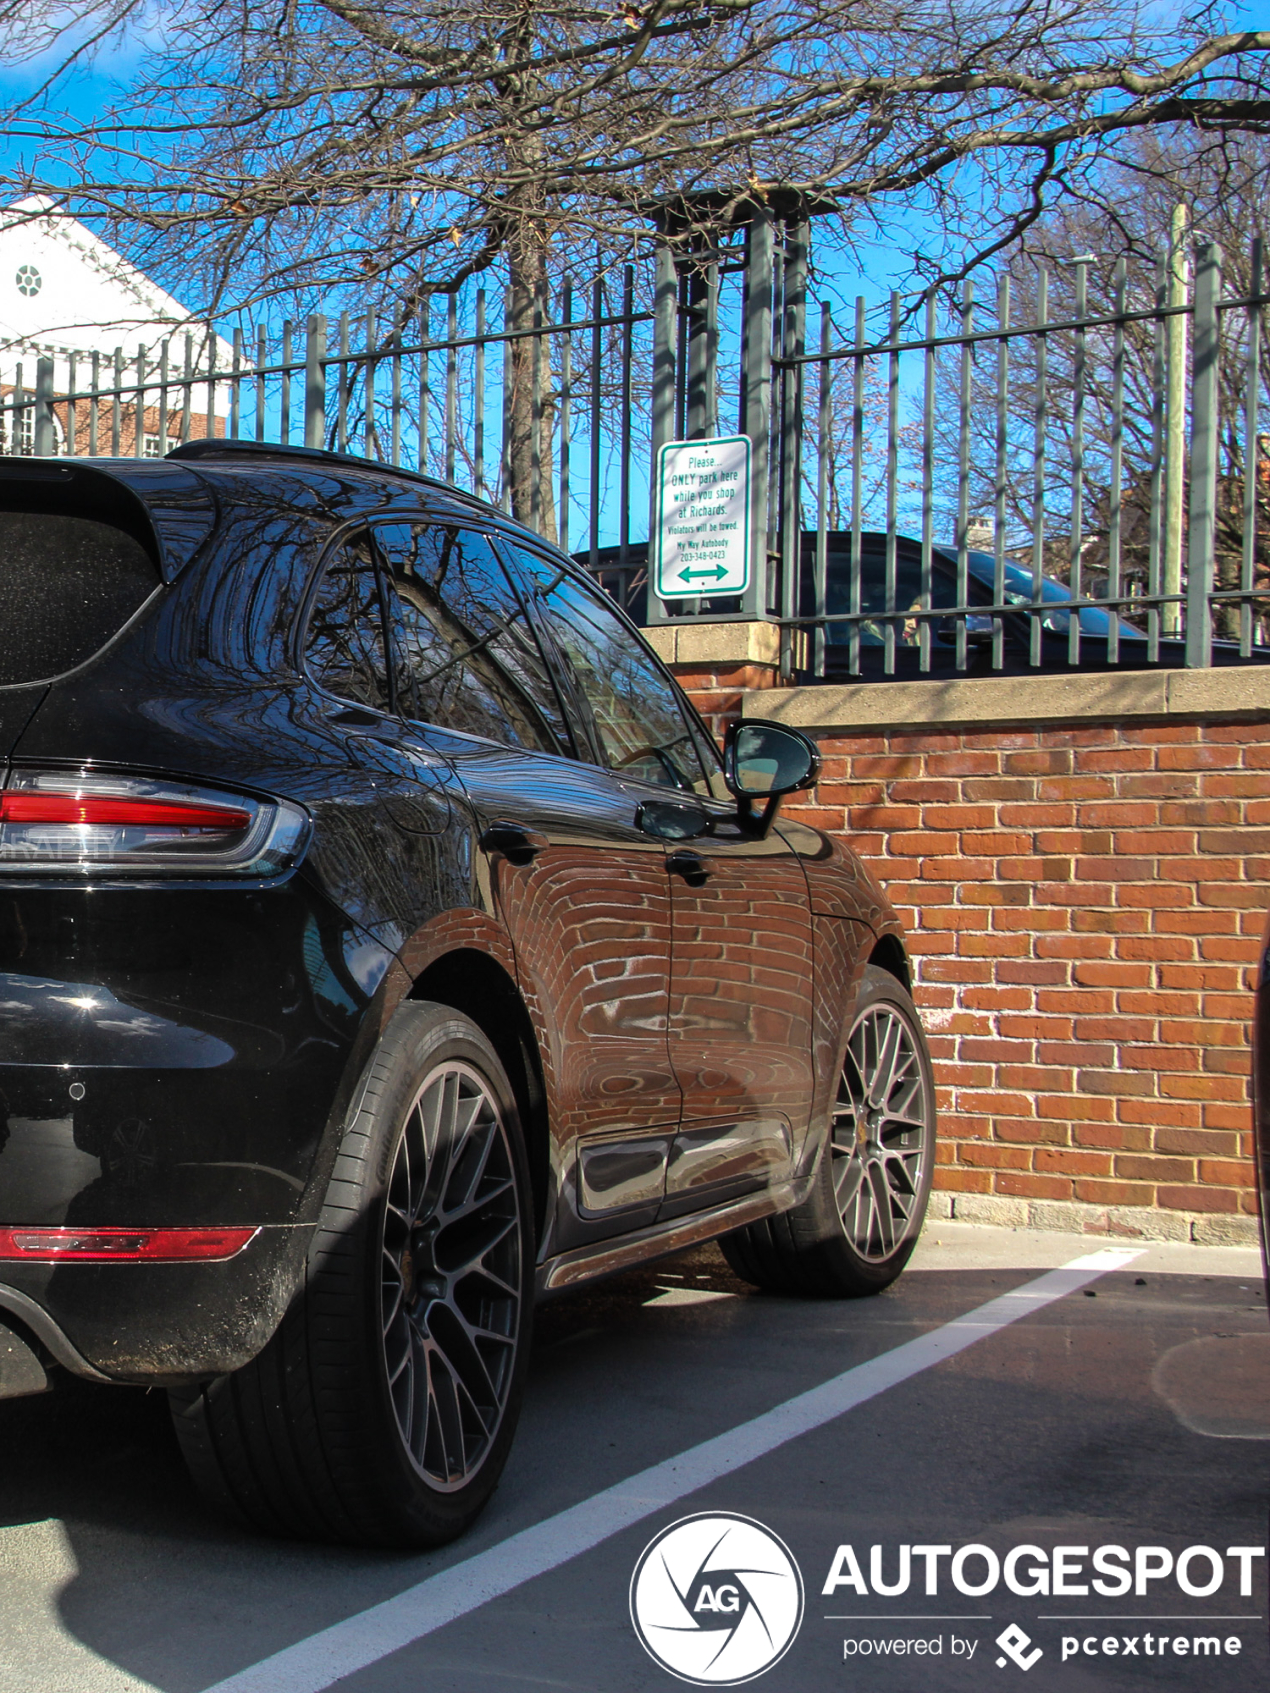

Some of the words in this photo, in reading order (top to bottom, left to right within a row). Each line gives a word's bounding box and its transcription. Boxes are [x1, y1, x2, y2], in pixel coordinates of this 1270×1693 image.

[688, 457, 722, 469] Please...
[671, 473, 696, 486] ONLY
[698, 471, 717, 487] park
[720, 470, 738, 482] here
[673, 490, 695, 502] while
[697, 489, 713, 503] you
[716, 487, 735, 500] shop
[678, 505, 687, 518] at
[690, 503, 728, 517] Richards.
[668, 524, 694, 535] Violators
[696, 523, 707, 533] will
[709, 522, 717, 531] be
[719, 520, 739, 531] towed.
[677, 541, 686, 551] My
[687, 540, 699, 550] Way
[701, 538, 729, 549] Autobody
[680, 550, 726, 562] 203-348-0423
